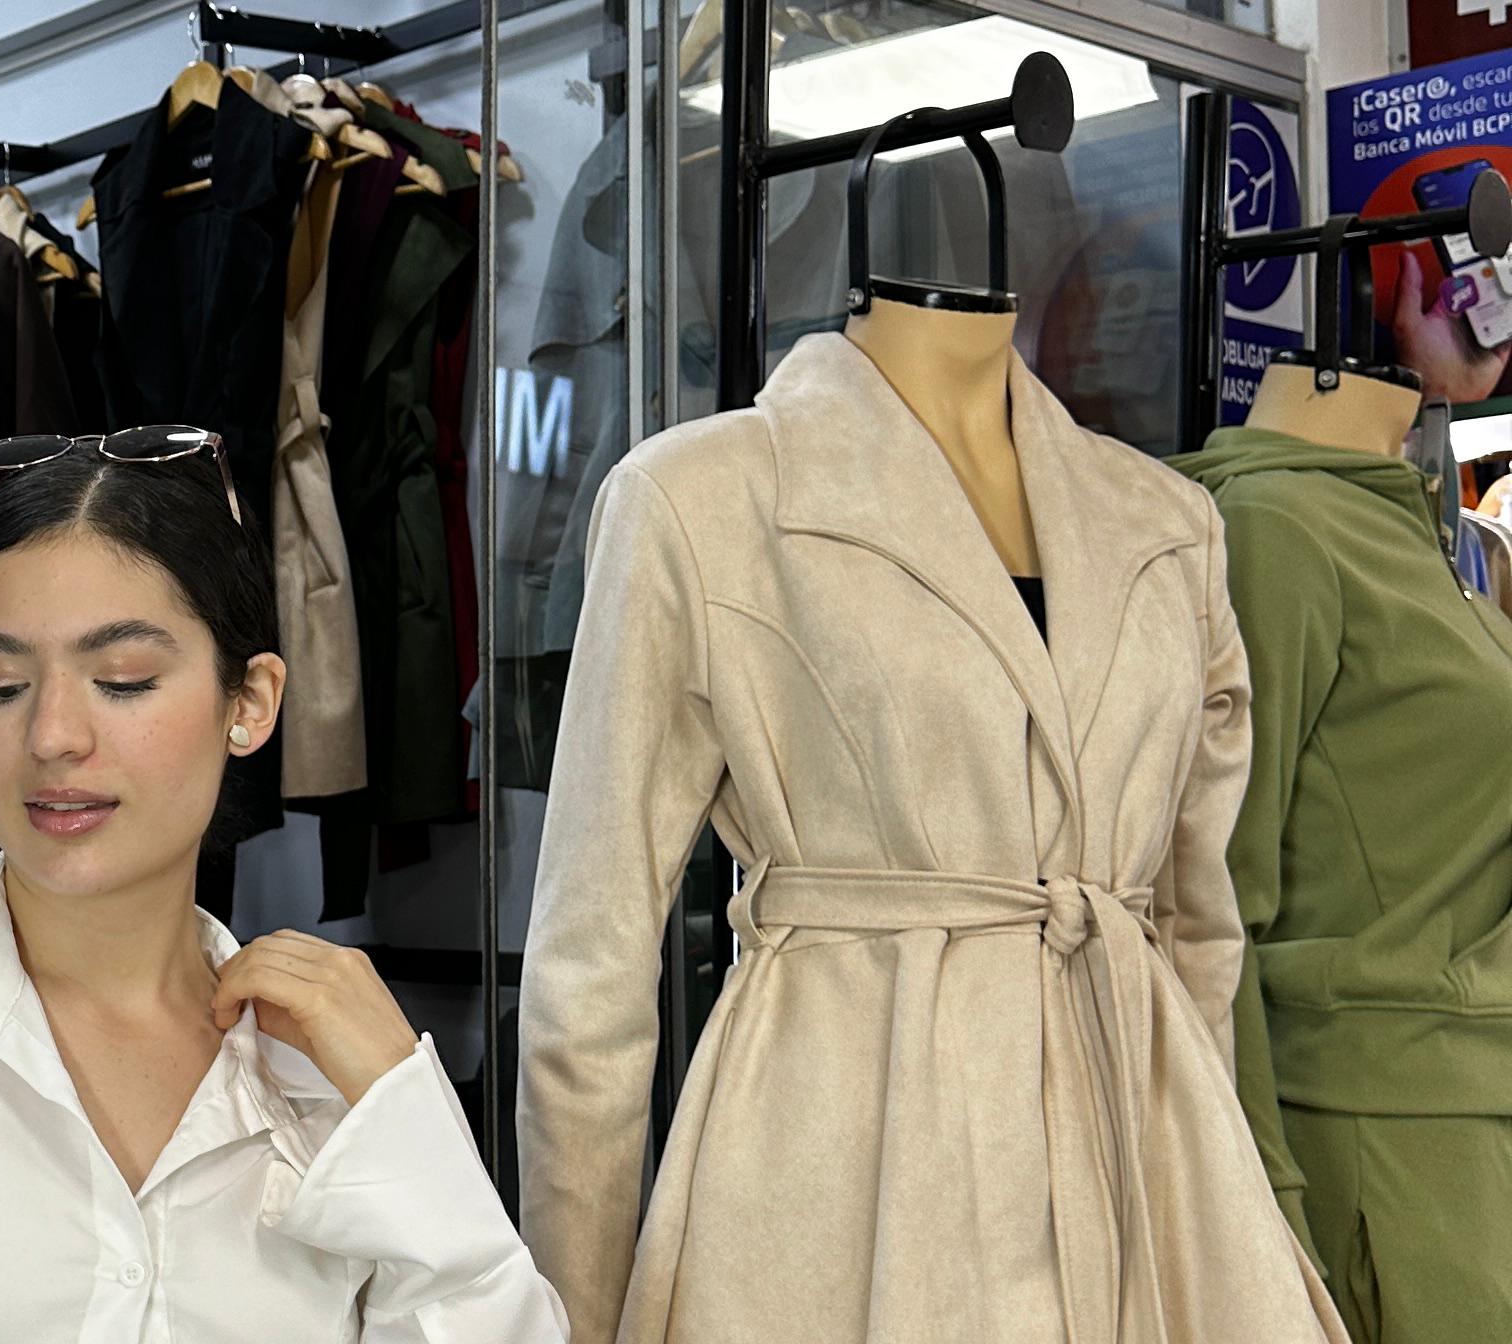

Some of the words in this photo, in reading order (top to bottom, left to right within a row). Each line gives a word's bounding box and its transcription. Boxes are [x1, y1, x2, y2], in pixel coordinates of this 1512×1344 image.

[1353, 119, 1380, 137] los
[1384, 102, 1422, 132] QR
[1428, 95, 1487, 121] desde
[1494, 91, 1512, 109] tu
[1354, 136, 1410, 160] Banca
[1415, 121, 1468, 148] Móvil
[1222, 376, 1259, 405] ASC
